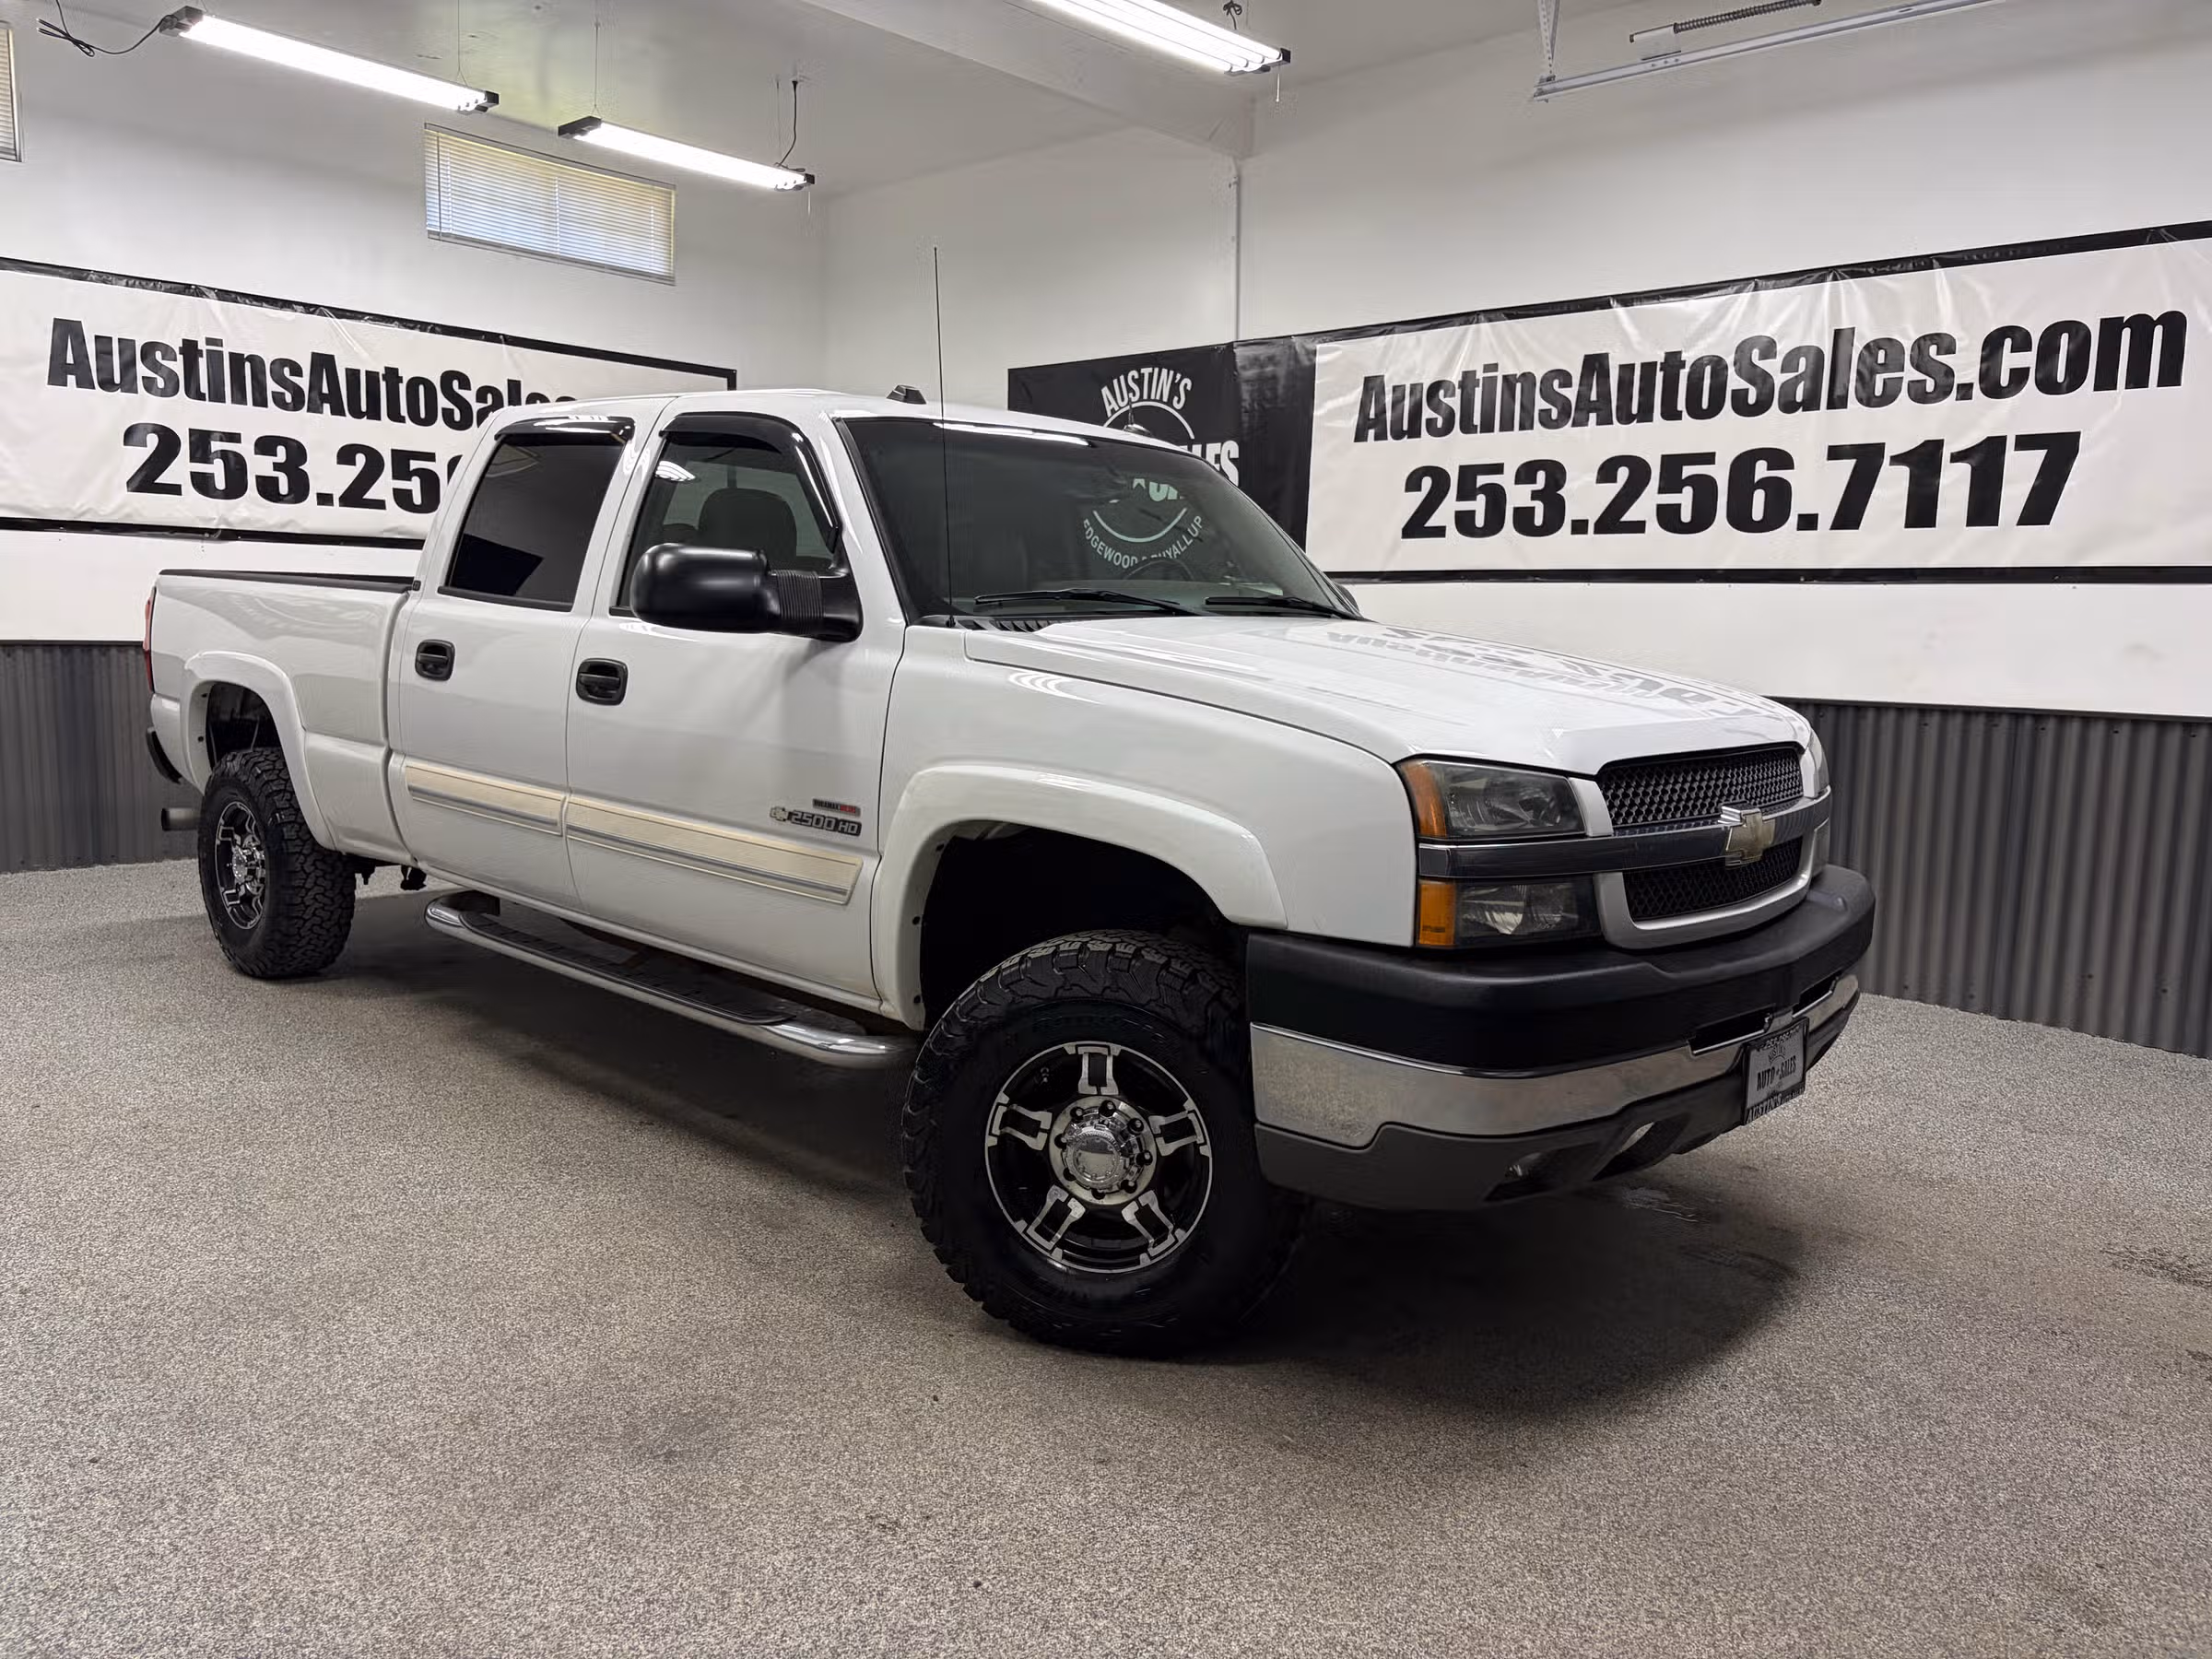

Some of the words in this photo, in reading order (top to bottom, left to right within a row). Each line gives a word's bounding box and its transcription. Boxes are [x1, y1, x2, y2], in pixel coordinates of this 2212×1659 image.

[46, 317, 577, 432] AustinsAutoSal
[1100, 367, 1193, 417] AUSTIN'S
[1352, 309, 2188, 443] AustinsAutoSales.com
[123, 422, 461, 514] 253.25
[1401, 430, 2082, 539] 253.256.7117
[1150, 515, 1204, 559] YALLUP
[791, 810, 836, 831] 2500
[838, 820, 858, 834] HD
[1757, 1066, 1776, 1092] AUTO
[1779, 1055, 1797, 1080] SALES
